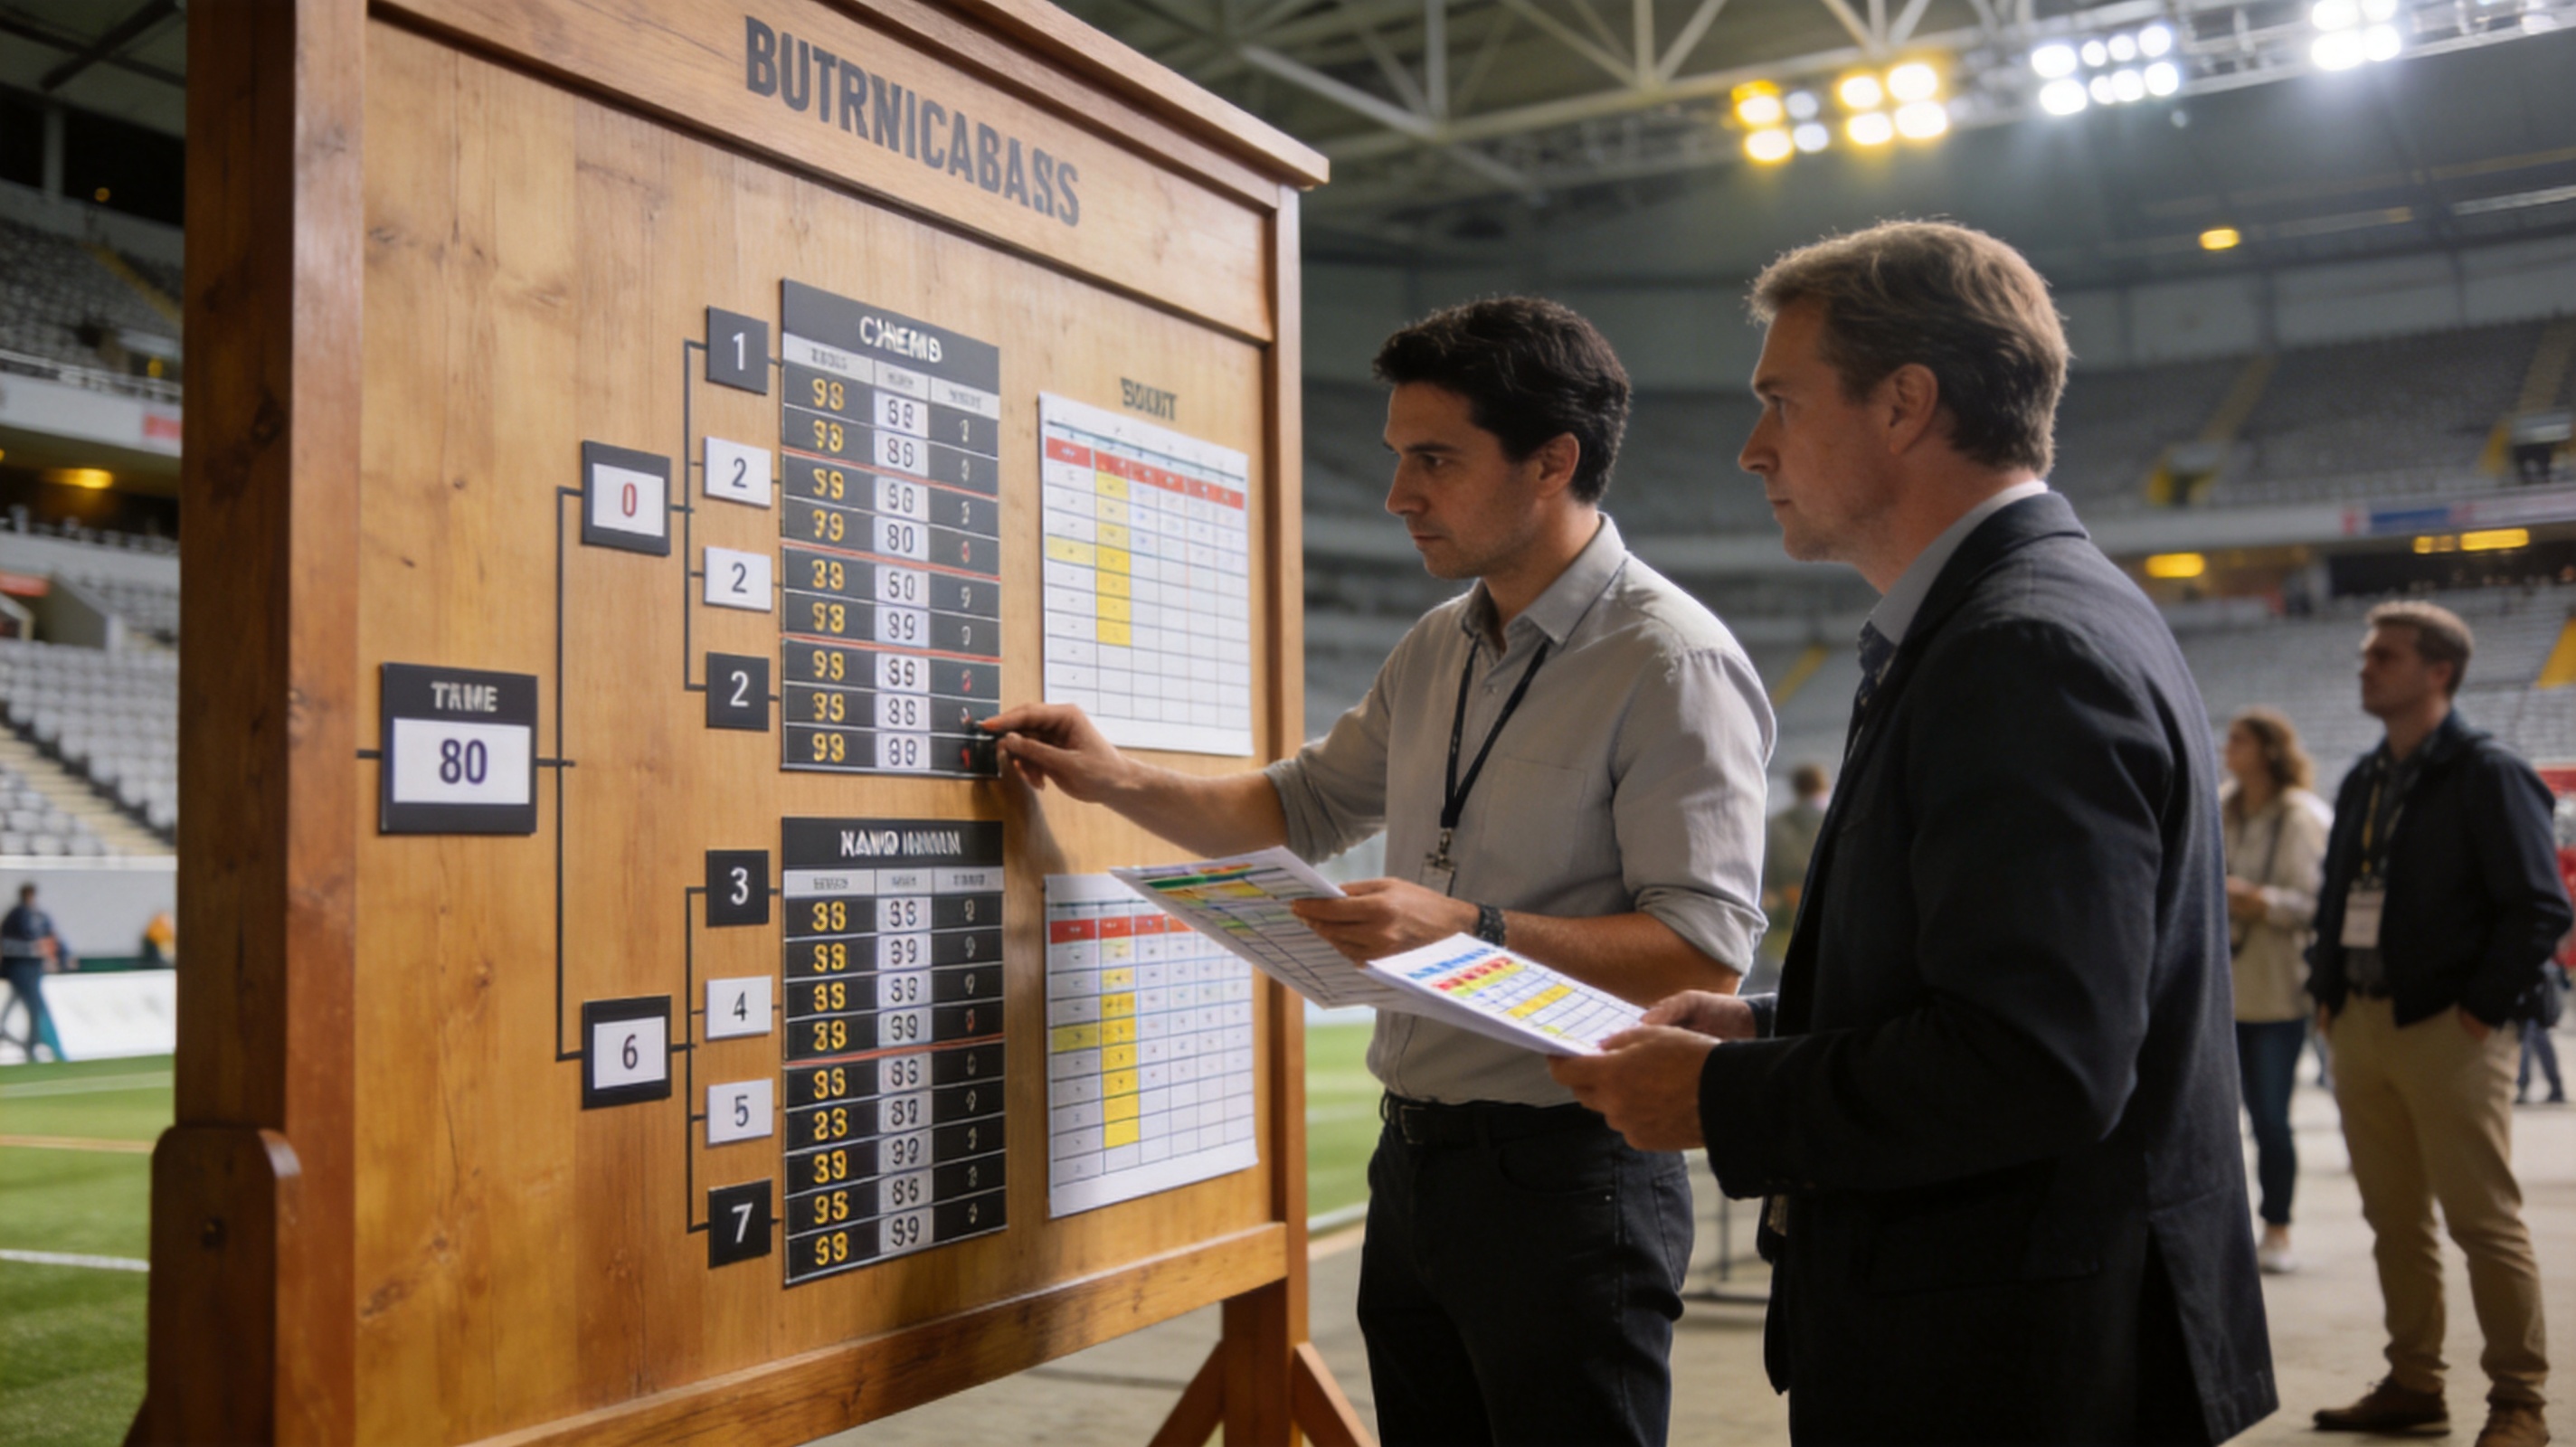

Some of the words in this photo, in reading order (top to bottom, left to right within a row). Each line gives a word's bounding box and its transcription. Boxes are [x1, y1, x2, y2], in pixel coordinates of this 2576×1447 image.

[733, 332, 744, 371] 1
[733, 458, 747, 488] 2
[622, 482, 638, 517] 0
[888, 524, 913, 553] 80
[733, 563, 747, 593] 2
[730, 670, 750, 707] 2
[439, 738, 488, 784] 80
[731, 867, 749, 905] 3
[734, 991, 749, 1021] 4
[622, 1034, 638, 1071] 6
[735, 1094, 749, 1128] 5
[732, 1203, 753, 1243] 7
